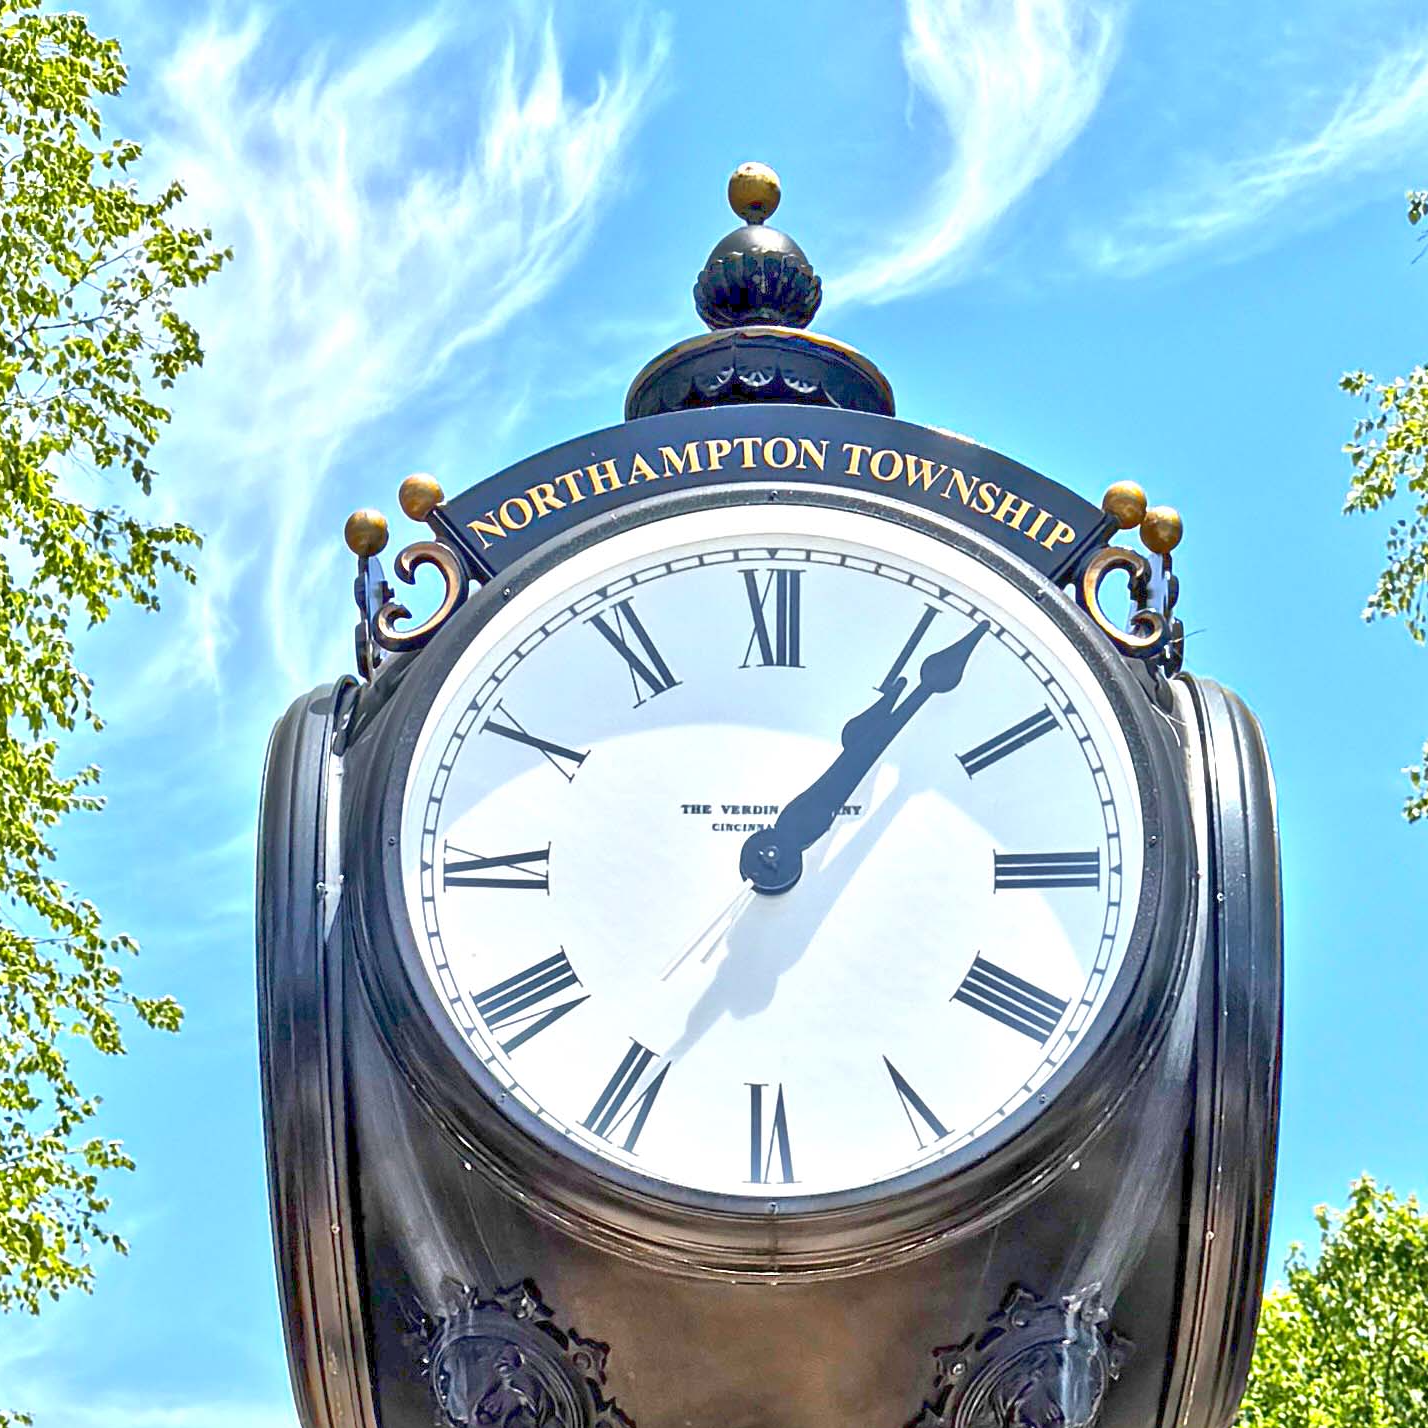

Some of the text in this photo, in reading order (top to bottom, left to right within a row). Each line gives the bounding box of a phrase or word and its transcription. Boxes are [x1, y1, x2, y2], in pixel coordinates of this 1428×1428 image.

[467, 436, 1076, 551] NORTHAMPTON TOWNSHIP
[582, 596, 683, 708] XI
[737, 568, 806, 669] XII
[873, 603, 944, 697] I
[479, 699, 591, 783] X
[955, 703, 1063, 780] II
[680, 804, 779, 815] THE VERDIN
[712, 823, 777, 832] CINCINNA
[444, 840, 551, 895] IX
[993, 847, 1100, 895] III
[468, 944, 591, 1060] VIII
[949, 950, 1072, 1049] IIII
[575, 1036, 672, 1156] VII
[743, 1082, 803, 1185] VI
[882, 1054, 955, 1151] V
